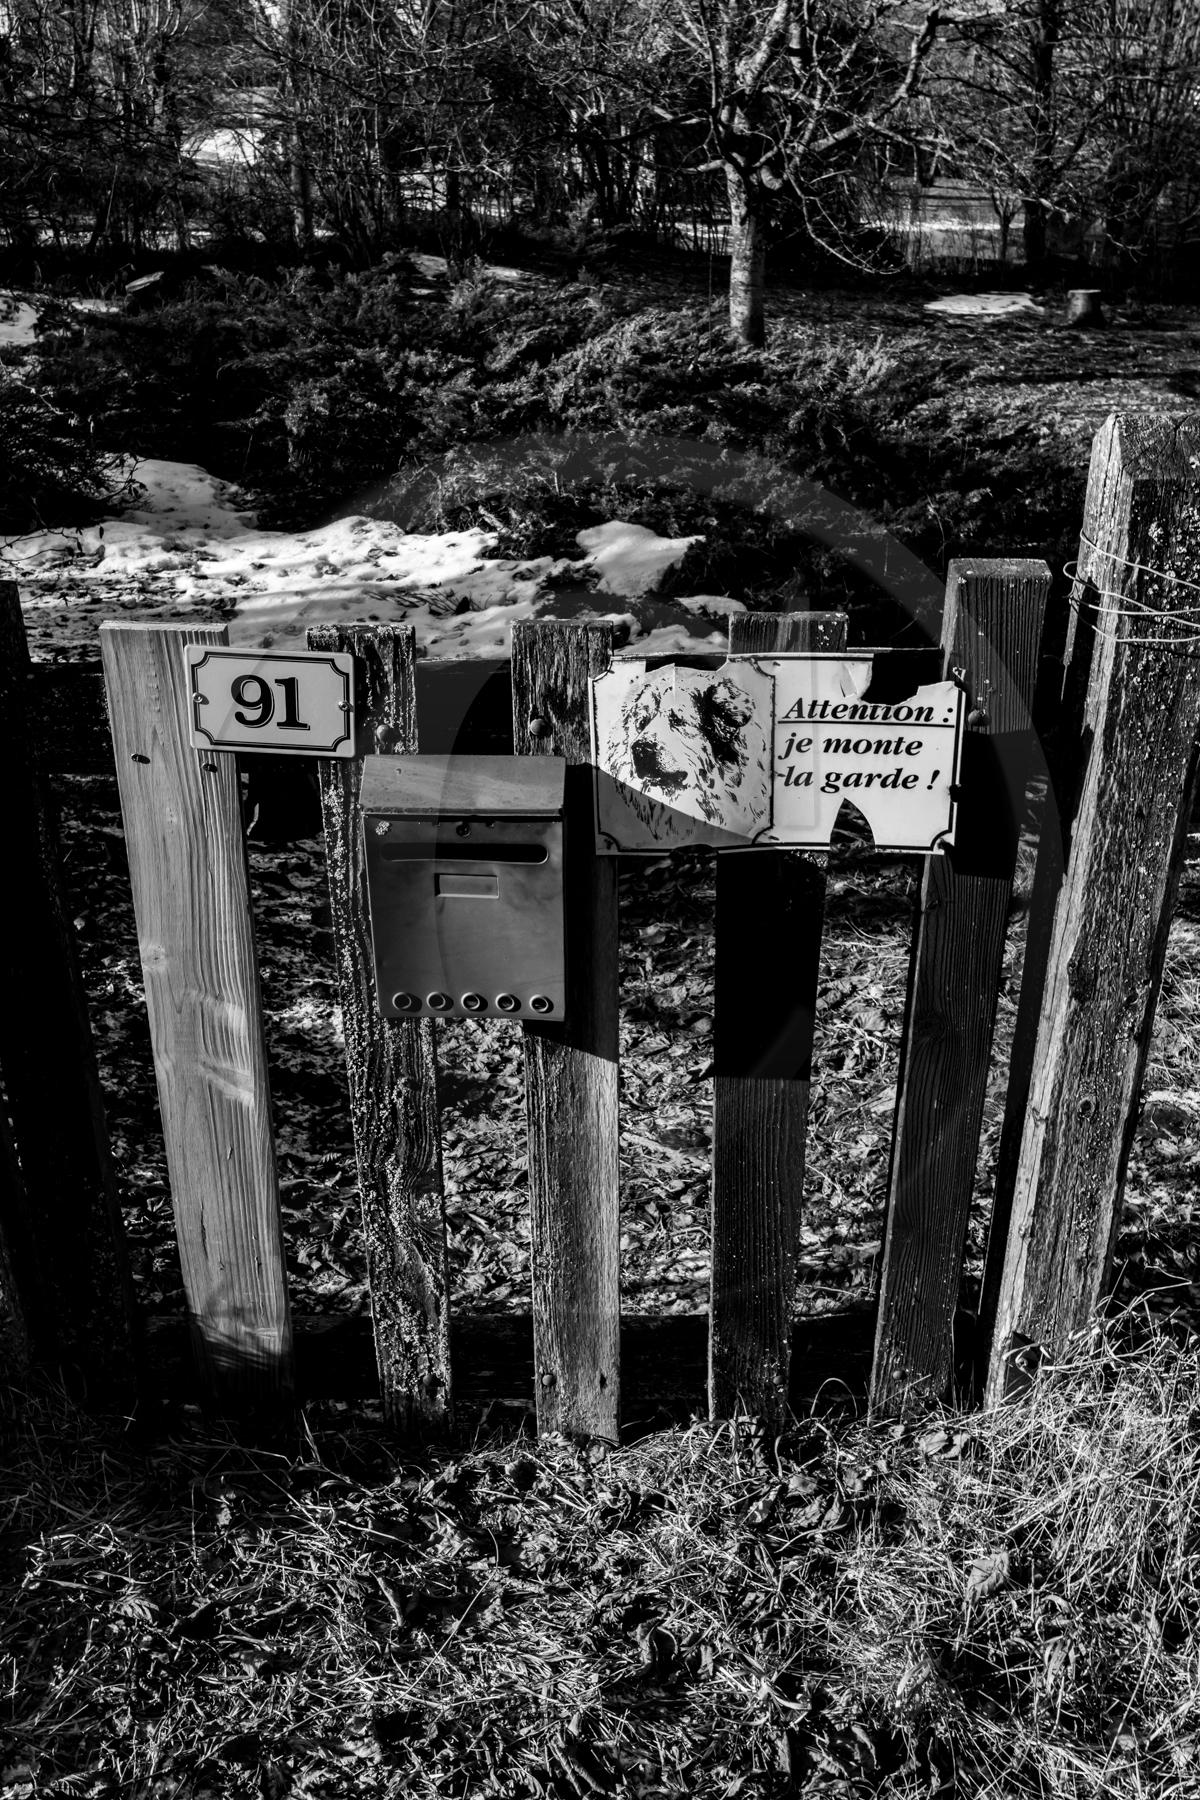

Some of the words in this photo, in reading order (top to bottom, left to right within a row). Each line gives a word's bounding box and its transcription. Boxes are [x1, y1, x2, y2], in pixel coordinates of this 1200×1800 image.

[230, 674, 311, 731] 91
[781, 697, 935, 723] Attention
[777, 731, 814, 761] je
[822, 736, 924, 756] monte
[783, 765, 814, 788] la
[819, 767, 920, 794] garde
